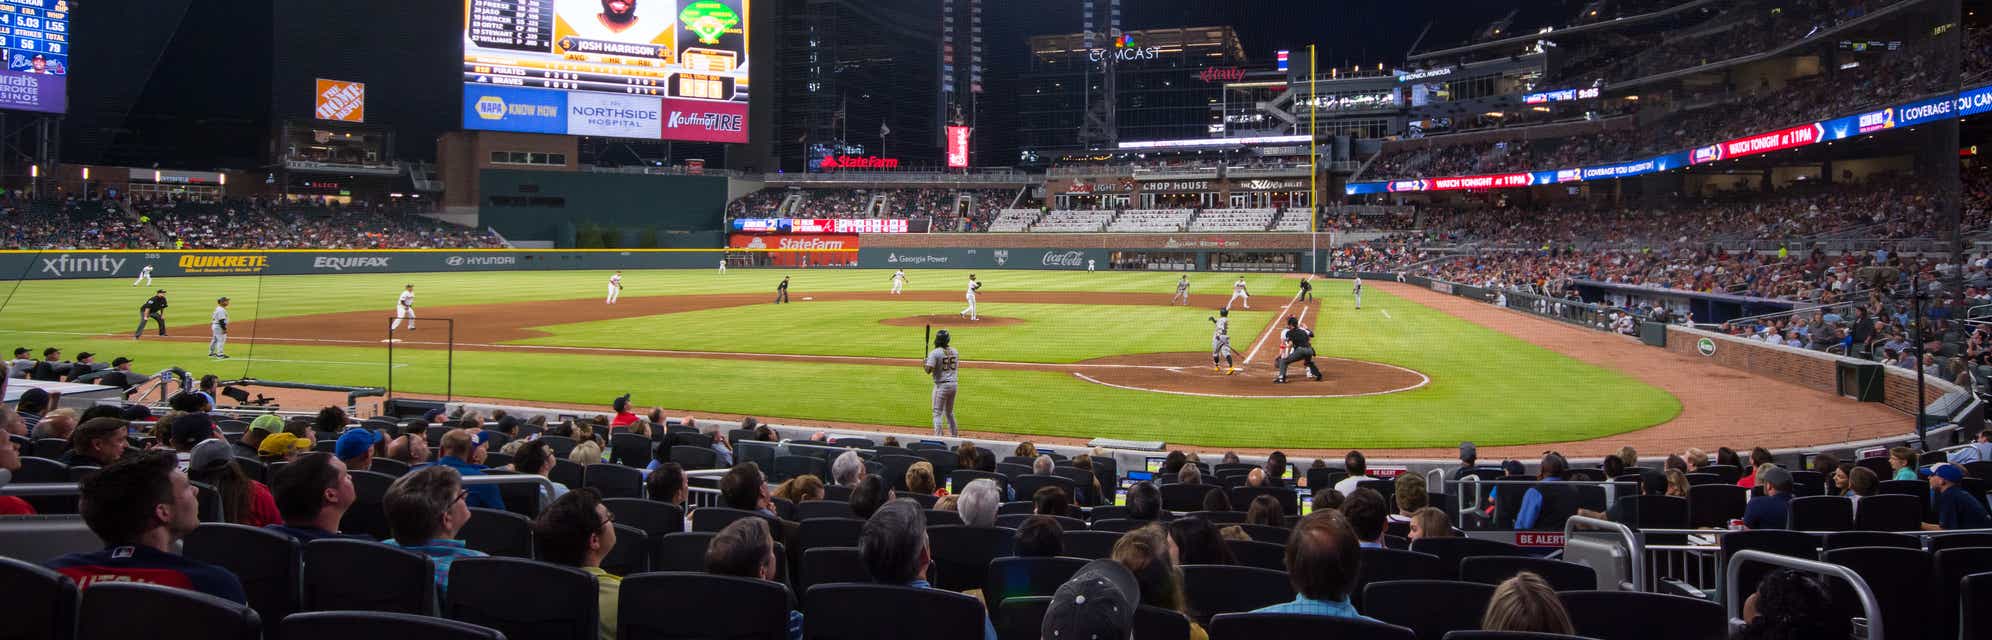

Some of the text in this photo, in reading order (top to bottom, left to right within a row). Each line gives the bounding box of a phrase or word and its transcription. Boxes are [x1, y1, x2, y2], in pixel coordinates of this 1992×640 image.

[16, 16, 40, 28] 5.03
[45, 20, 65, 32] 1.55
[481, 22, 504, 30] ORTIZ
[45, 32, 65, 42] TOTAL
[20, 39, 34, 50] 56
[578, 41, 602, 51] JOSH
[603, 43, 655, 56] HARRISON
[492, 67, 526, 76] PIRATES
[1200, 66, 1246, 82] xfinity
[1406, 68, 1451, 80] KONICA MINOLTA
[492, 77, 524, 86] BRAVES
[321, 84, 341, 99] THE
[1578, 88, 1599, 98] 9:05
[318, 82, 364, 119] HOME
[335, 98, 361, 120] DEPOT
[480, 103, 557, 117] NAPA KNOW HOW
[573, 106, 657, 120] NORTHSIDE
[1884, 107, 1895, 128] 2
[1905, 100, 1951, 120] COVERAGE
[1952, 96, 1971, 111] YOU
[1974, 91, 1992, 107] CAN
[588, 119, 643, 128] HOSPITAL
[668, 111, 742, 132] Kauffman TIRE
[1729, 140, 1750, 154] WATCH
[1751, 135, 1779, 150] TONIGHT
[1790, 128, 1812, 144] 11PM
[1587, 167, 1615, 177] COVERAGE
[1615, 166, 1628, 174] YOU
[1093, 183, 1116, 191] LIGHT
[1143, 181, 1208, 190] CHOP HOUSE
[1250, 180, 1283, 189] Silver
[1436, 179, 1460, 188] WATCH
[1461, 177, 1492, 187] TONIGHT
[1504, 175, 1526, 185] 11PM
[42, 254, 127, 276] xfinity
[178, 255, 268, 268] QUIKRETE
[313, 257, 390, 270] EQUIFAX
[467, 256, 515, 264] HYUNDAI
[899, 256, 926, 264] Georgia
[1520, 535, 1565, 545] BE ALERT
